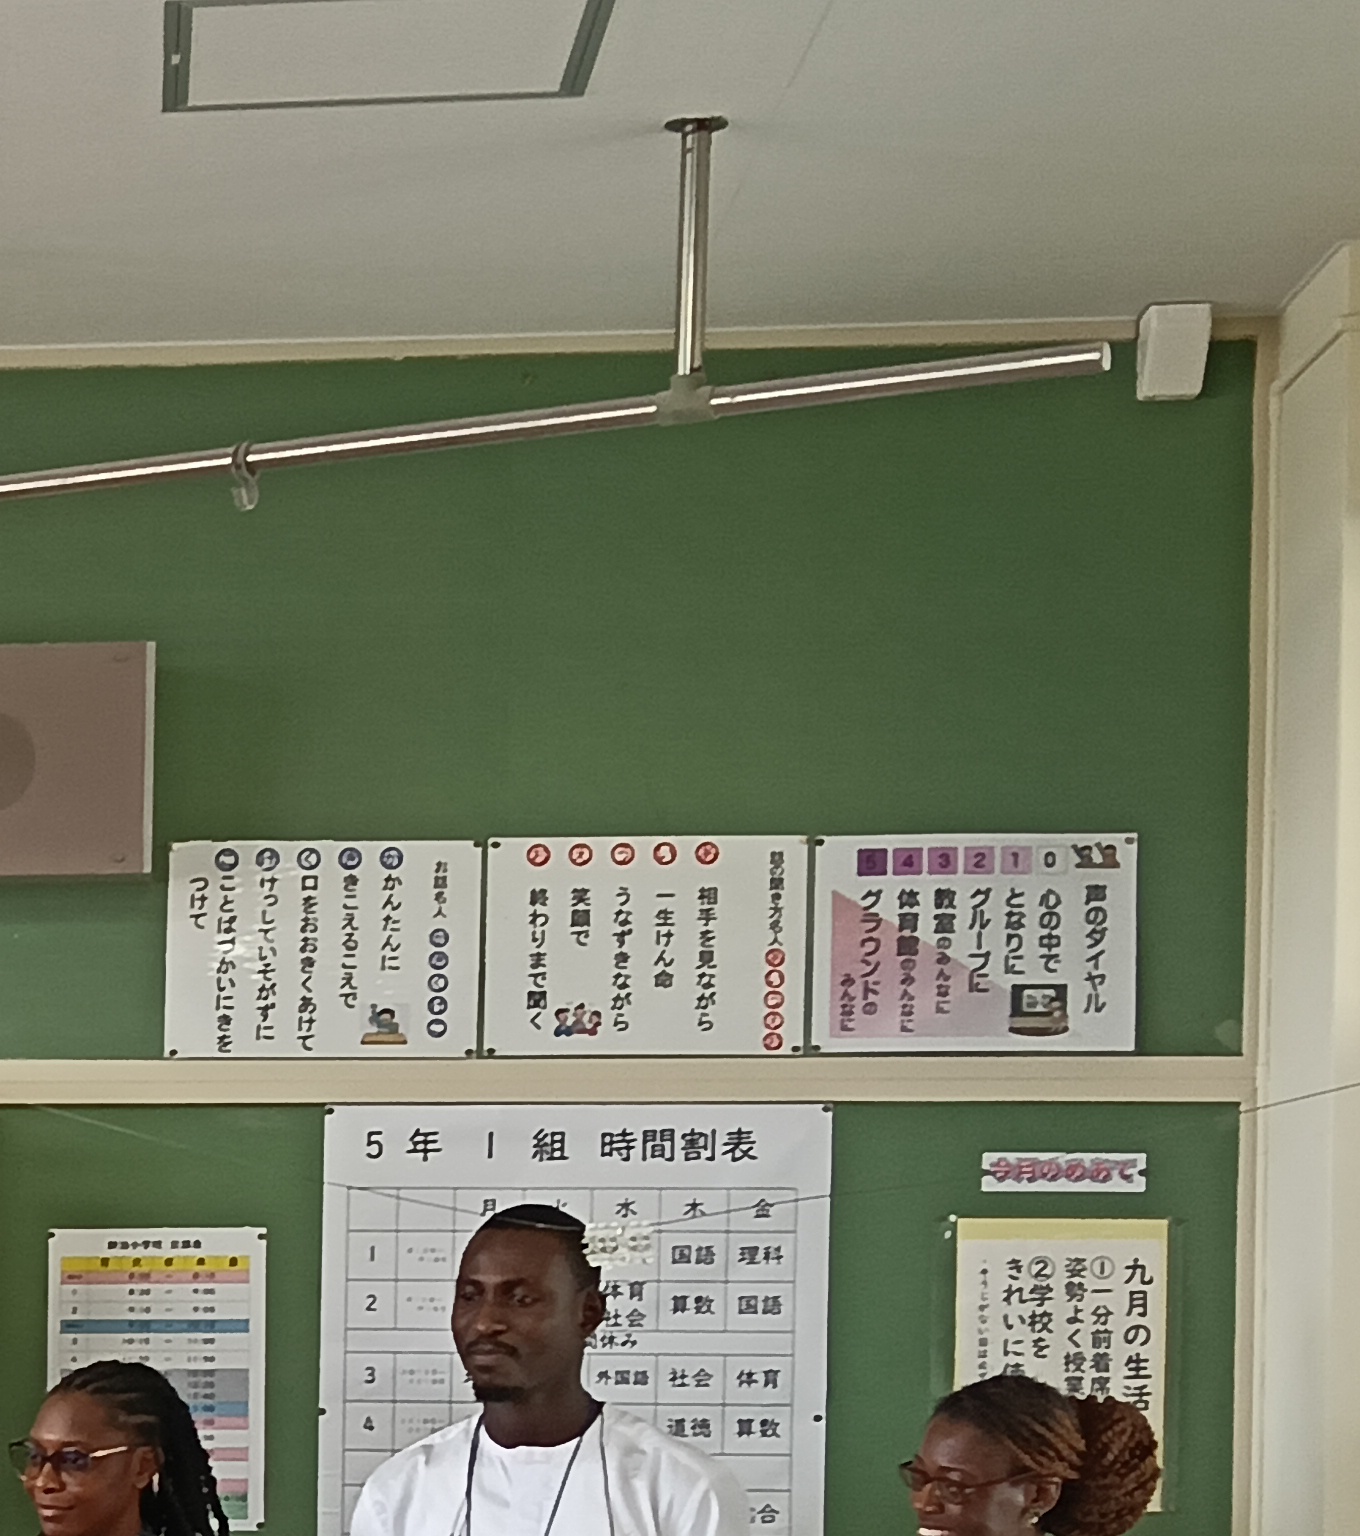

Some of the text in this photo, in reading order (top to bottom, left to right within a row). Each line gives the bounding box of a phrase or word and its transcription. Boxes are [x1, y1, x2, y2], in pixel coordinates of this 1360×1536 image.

[902, 853, 915, 868] 4
[938, 852, 951, 869] 3
[188, 876, 210, 930] つけて
[380, 873, 402, 971] かんたんに
[967, 851, 992, 993] 2 グループに
[1038, 851, 1063, 974] 0 心の中で
[338, 873, 360, 1010] きこえるこえで
[653, 892, 676, 989] 一生けん命
[1004, 887, 1027, 975] となりに
[296, 874, 319, 1052] 口をおおきくあけて
[610, 886, 633, 1032] うなずきながら
[694, 886, 719, 1032] 相手を見ながら
[365, 1129, 384, 1160] 5
[405, 1127, 443, 1161] 年
[531, 1128, 569, 1161] 組
[600, 1127, 759, 1163] 時間割表
[615, 1198, 637, 1218] 水
[683, 1198, 706, 1218] 木
[671, 1245, 716, 1265] 国語
[365, 1295, 377, 1312] 2
[1028, 1283, 1055, 1359] 学校を
[1123, 1256, 1154, 1413] 九月の生活
[364, 1367, 376, 1384] 3
[668, 1368, 713, 1388] 社会
[737, 1368, 781, 1389] 体育
[362, 1416, 375, 1432] 4
